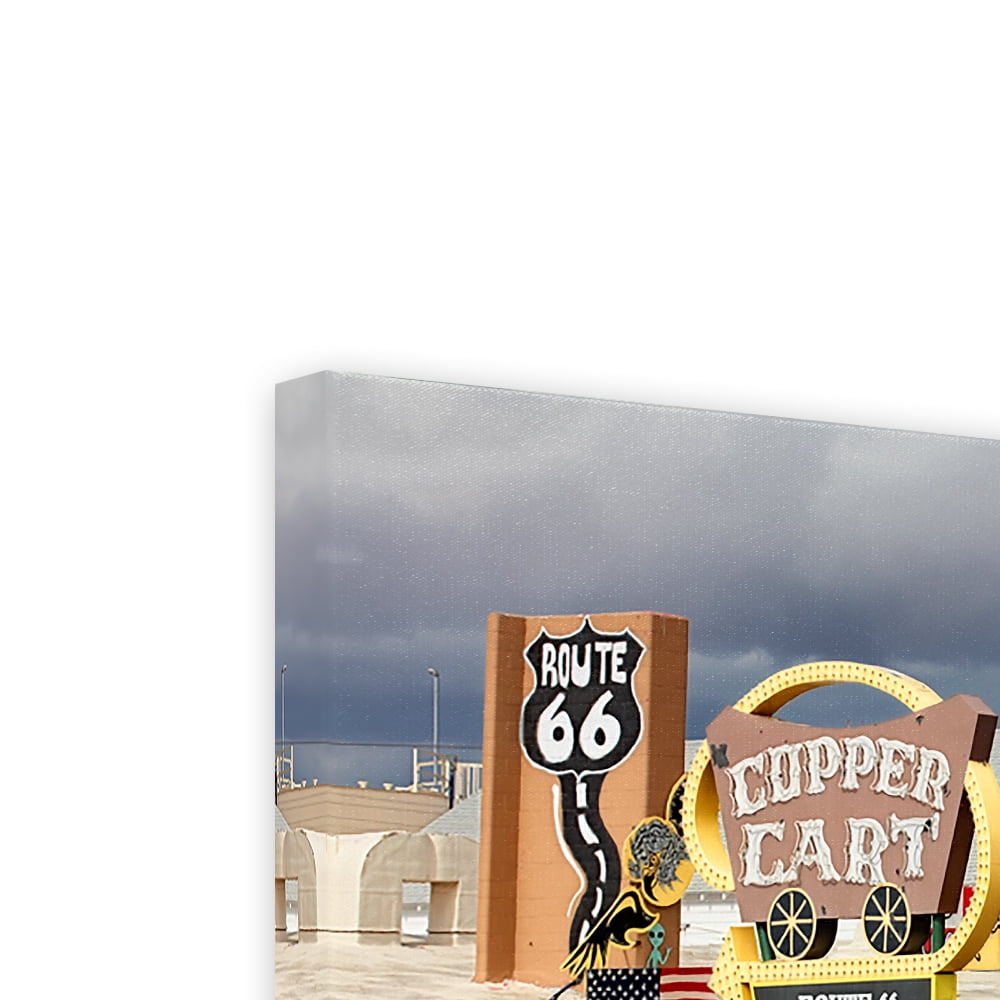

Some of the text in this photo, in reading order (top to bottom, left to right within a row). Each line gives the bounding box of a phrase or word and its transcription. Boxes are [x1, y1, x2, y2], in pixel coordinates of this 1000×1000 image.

[541, 642, 627, 688] ROUTE
[536, 690, 622, 764] 66
[725, 735, 952, 818] COPPER
[738, 813, 940, 887] CART
